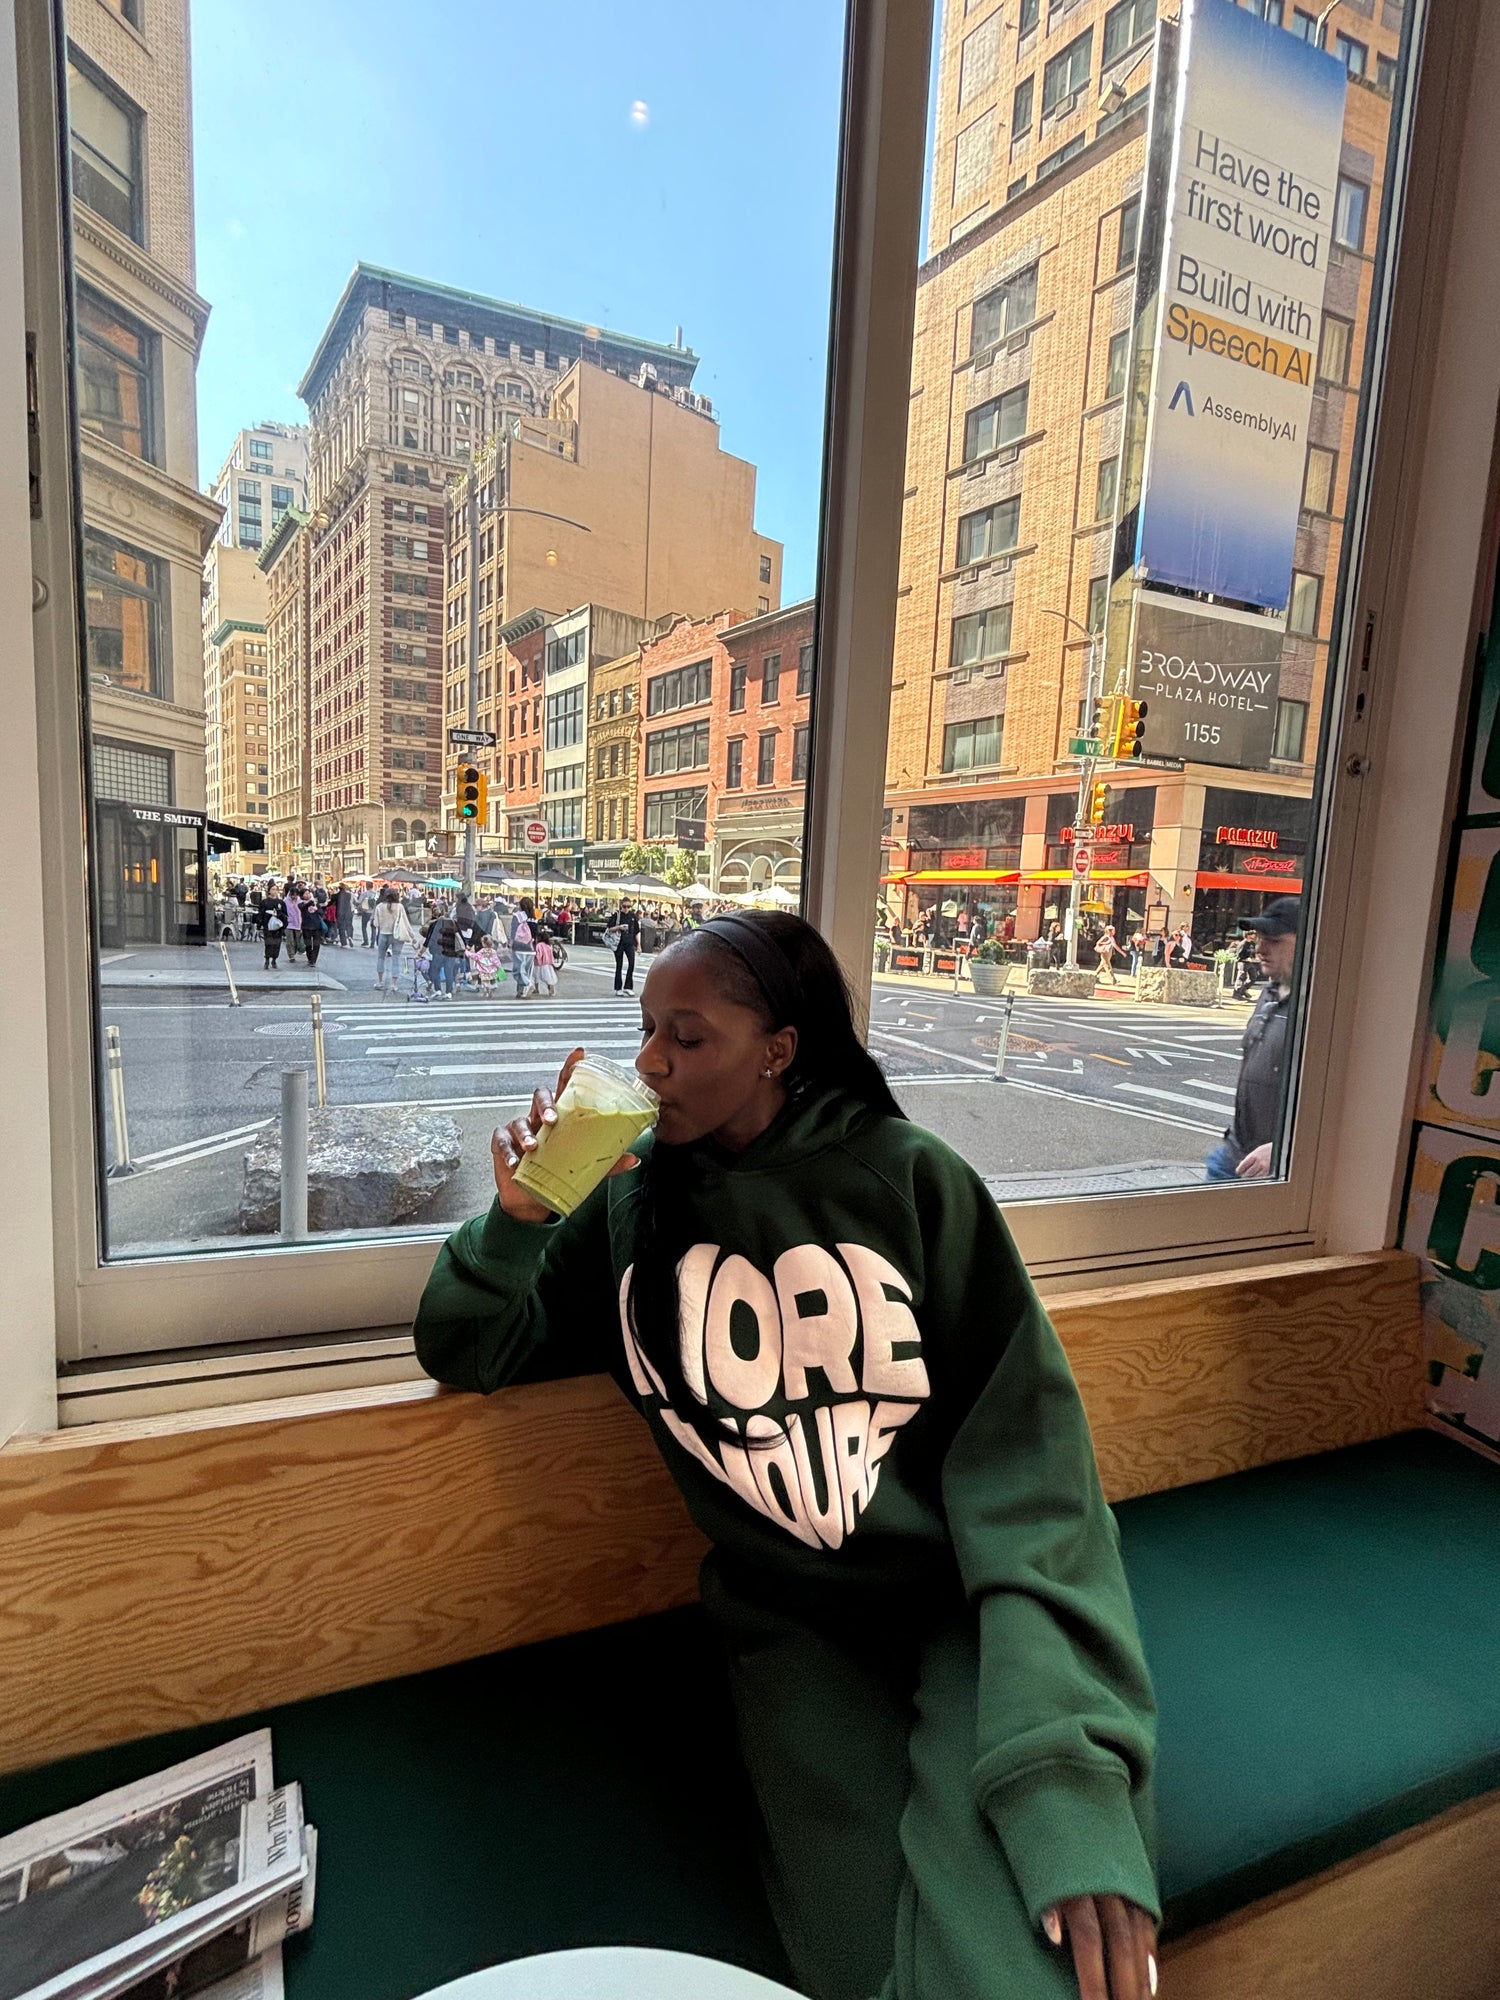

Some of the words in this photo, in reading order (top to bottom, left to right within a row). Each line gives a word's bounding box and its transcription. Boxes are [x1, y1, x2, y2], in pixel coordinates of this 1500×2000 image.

[1195, 130, 1270, 197] Have
[1277, 172, 1321, 220] the
[1187, 180, 1243, 237] first
[1249, 216, 1319, 269] word
[1177, 253, 1251, 316] Build
[1257, 295, 1312, 341] with
[1166, 302, 1279, 375] Speech
[1284, 351, 1312, 387] AI
[1202, 396, 1297, 442] AssemblyAI
[1141, 650, 1272, 694] BROADWAY
[1155, 683, 1202, 704] PLAZA
[1208, 692, 1254, 712] HOTEL
[456, 733, 470, 741] ONE
[475, 735, 490, 743] WAY
[1085, 741, 1095, 754] W
[1184, 722, 1221, 745] 1155
[1165, 760, 1182, 769] MEDIA
[132, 809, 161, 821] THE
[164, 813, 203, 826] SMITH
[1216, 825, 1279, 850] MAMAZUL
[267, 1828, 292, 1867] Why
